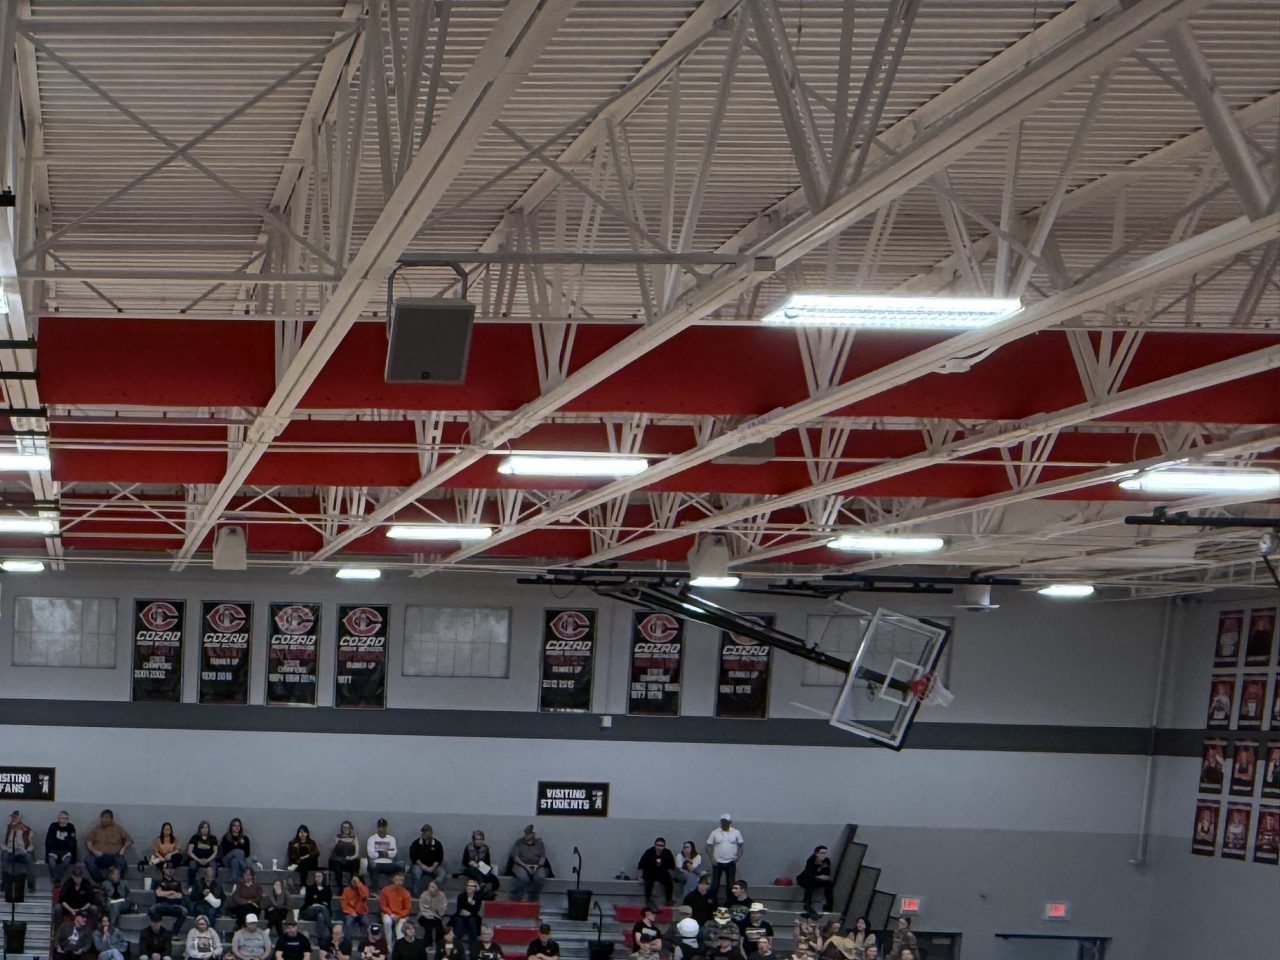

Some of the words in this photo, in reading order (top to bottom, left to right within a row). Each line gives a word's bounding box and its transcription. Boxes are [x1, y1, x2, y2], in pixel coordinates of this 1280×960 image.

[136, 631, 181, 640] COZAD
[204, 633, 248, 642] COZAD
[271, 635, 316, 644] COZAD
[340, 637, 384, 646] COZAD
[546, 640, 592, 650] COZAD
[635, 643, 680, 652] COZAD
[722, 645, 770, 655] COZAD
[0, 783, 24, 793] FANS
[546, 789, 586, 798] VISITING
[540, 799, 590, 809] STUDENTS
